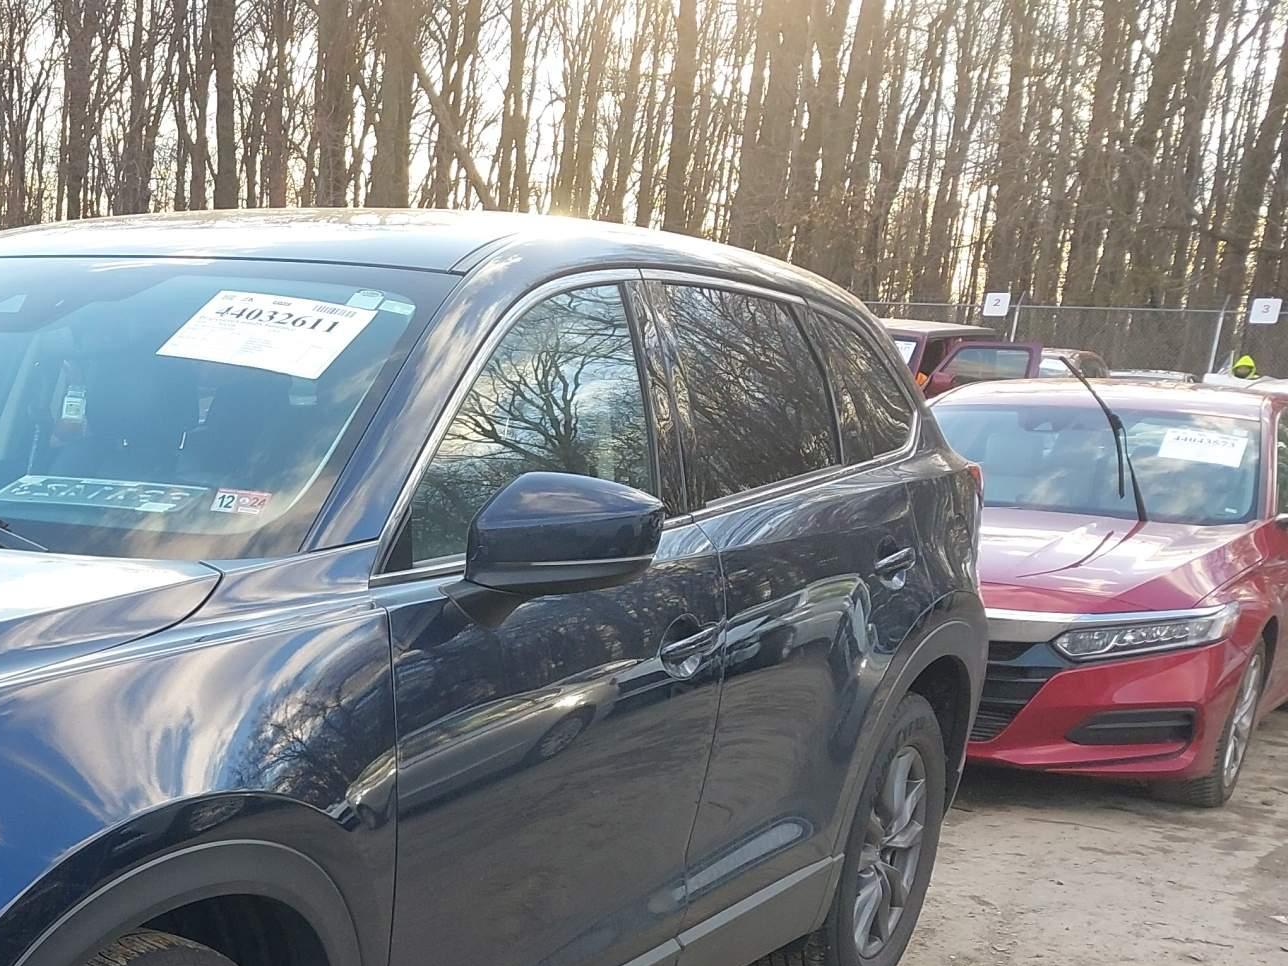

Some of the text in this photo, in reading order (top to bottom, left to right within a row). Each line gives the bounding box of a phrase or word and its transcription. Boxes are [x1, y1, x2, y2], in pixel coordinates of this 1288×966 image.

[992, 298, 1001, 307] 2
[1262, 304, 1272, 314] 3
[215, 305, 340, 333] 44032611
[218, 494, 235, 509] 12
